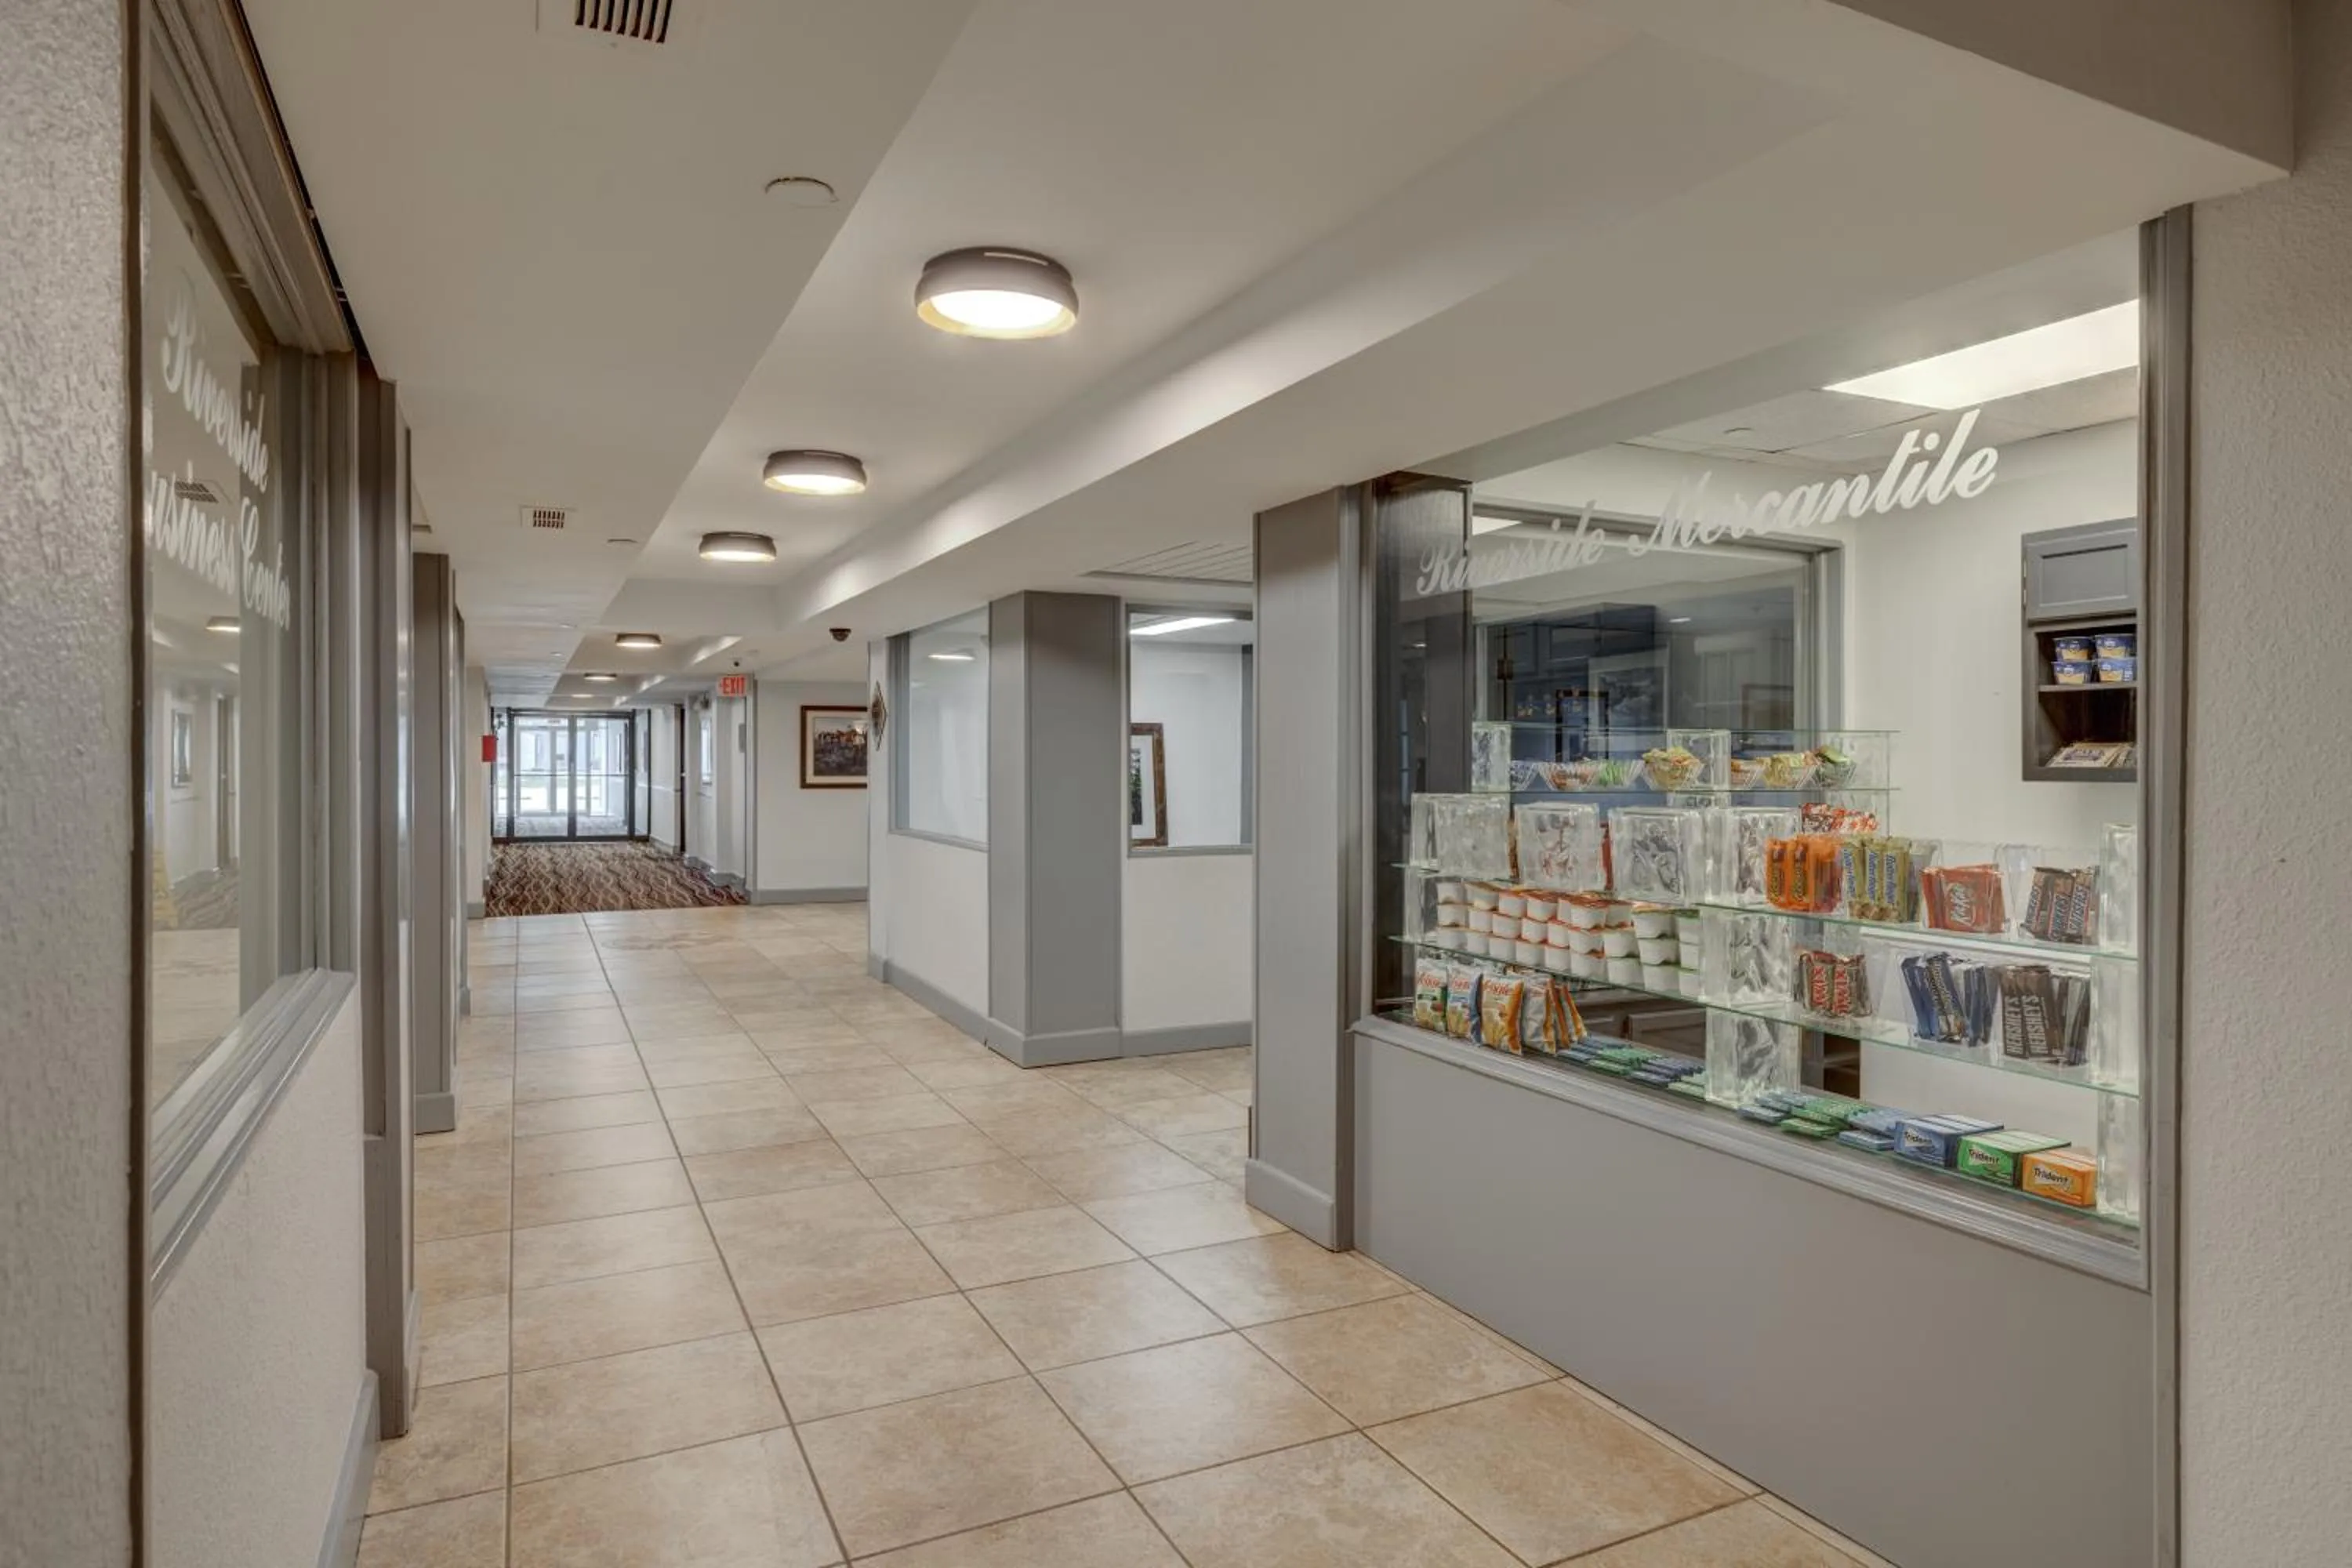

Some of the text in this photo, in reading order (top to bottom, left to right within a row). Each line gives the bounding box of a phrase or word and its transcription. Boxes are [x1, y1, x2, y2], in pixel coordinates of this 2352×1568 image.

[1415, 409, 1999, 595] Riverside Mercantile
[147, 458, 291, 631] usiness Center
[722, 676, 745, 695] EXIT
[1968, 1147, 2001, 1165] Trident
[2033, 1166, 2070, 1188] Trident
